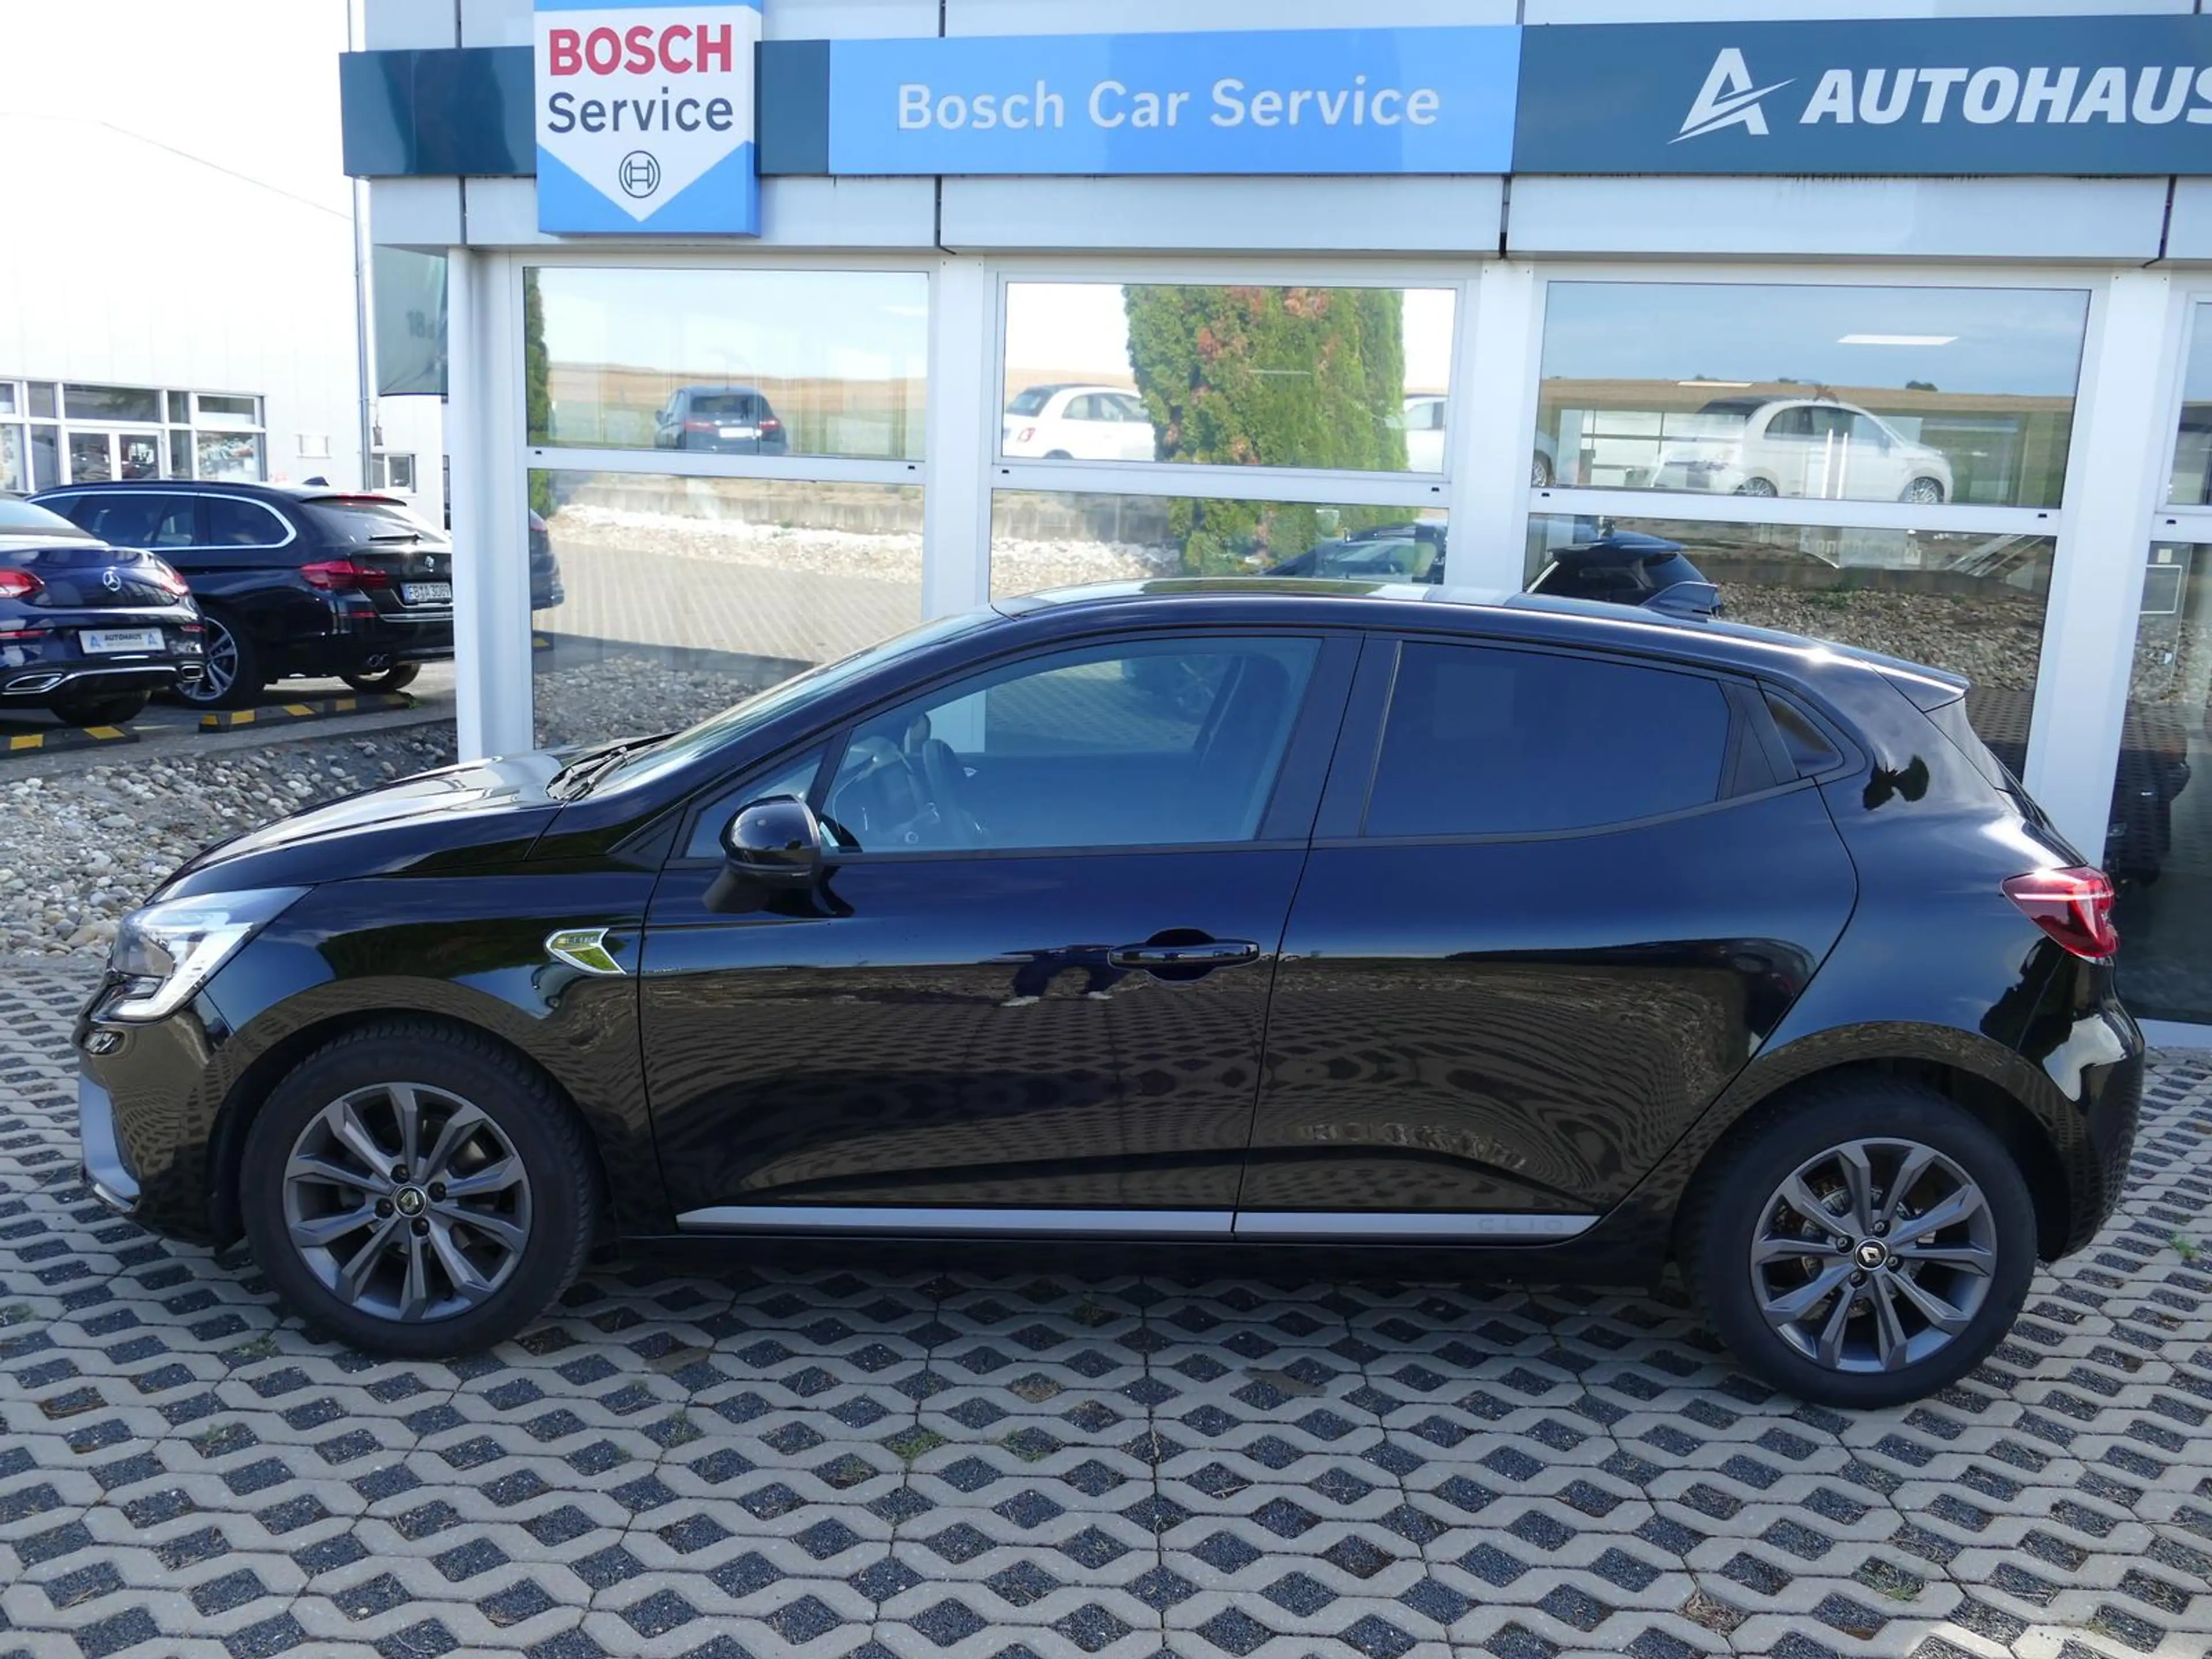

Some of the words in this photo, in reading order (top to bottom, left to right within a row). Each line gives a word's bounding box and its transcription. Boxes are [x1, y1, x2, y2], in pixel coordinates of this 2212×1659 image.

[551, 25, 732, 75] BOSCH
[548, 86, 733, 133] Service
[899, 81, 1064, 130] Bosch
[1088, 81, 1190, 128] Car
[1210, 75, 1440, 126] Service
[1478, 1218, 1563, 1232] CLIO
